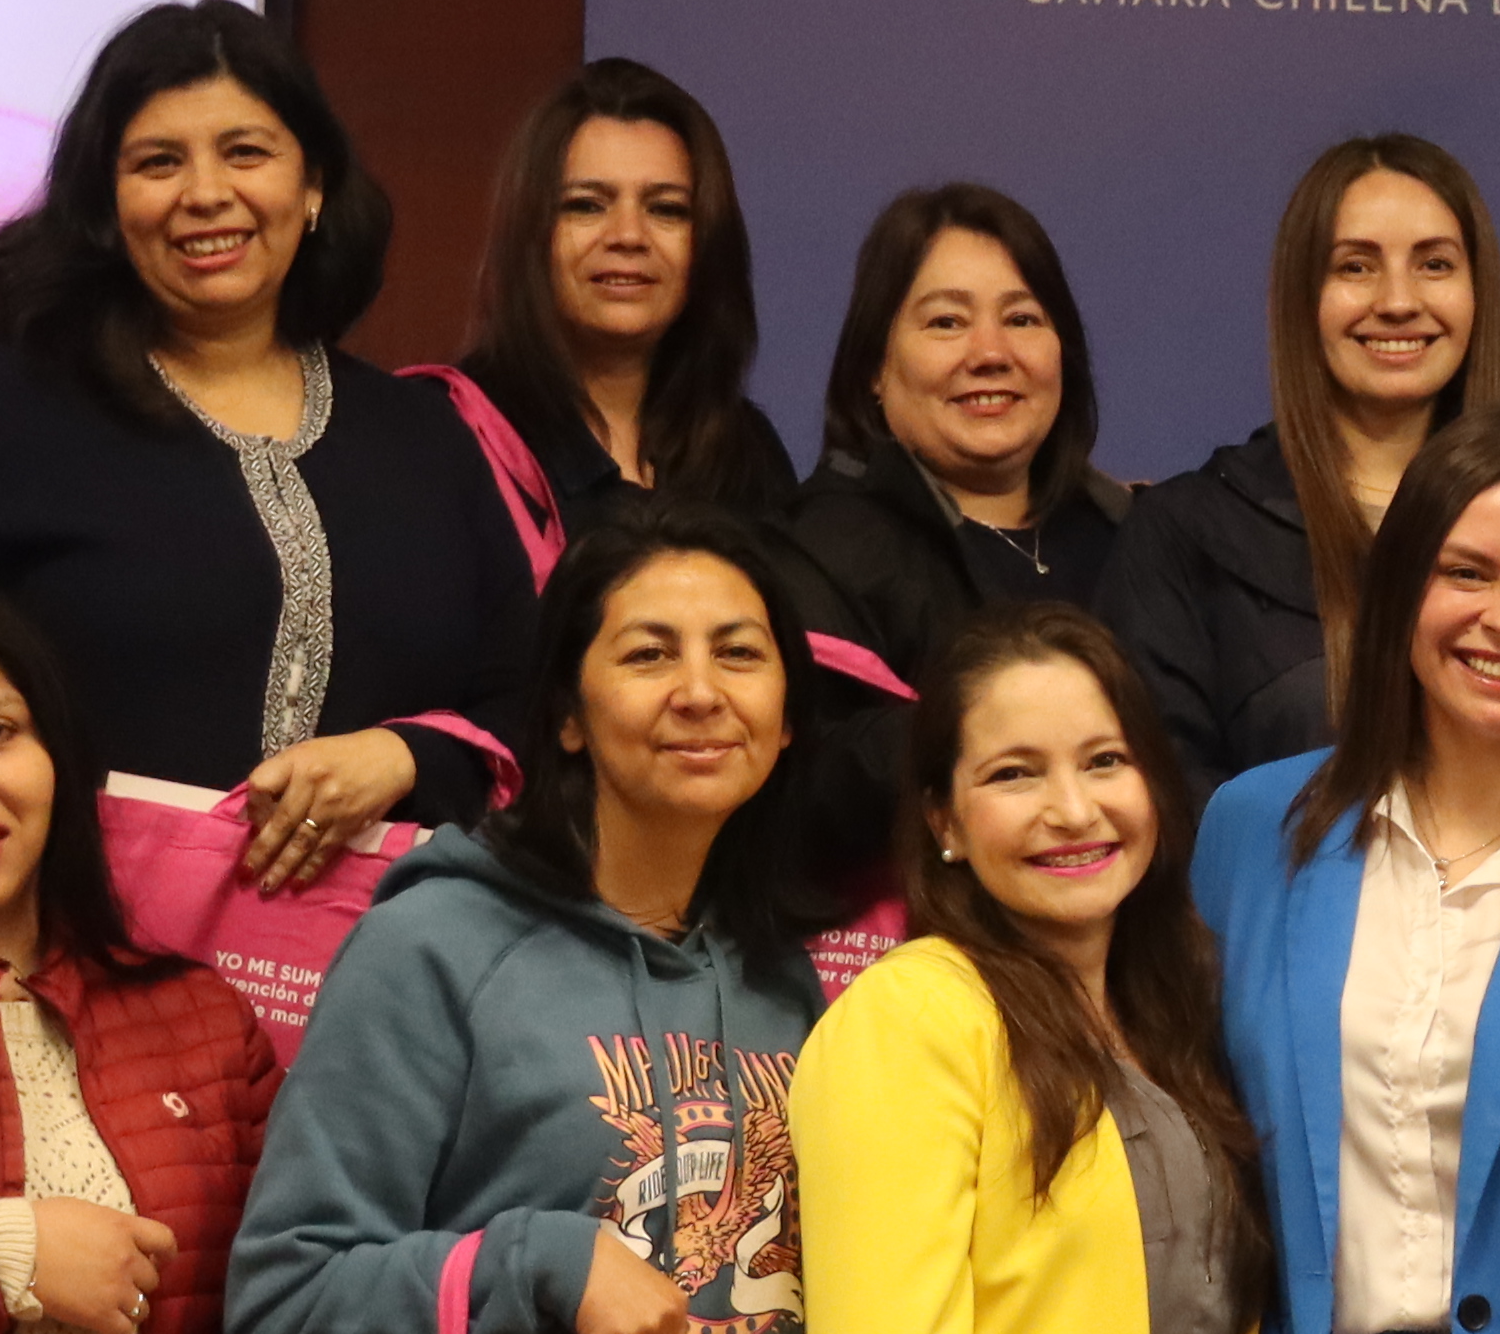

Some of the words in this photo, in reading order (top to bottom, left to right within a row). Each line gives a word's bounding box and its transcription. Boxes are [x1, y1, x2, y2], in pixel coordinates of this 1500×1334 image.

[844, 931, 867, 948] ME
[216, 950, 243, 970] YO
[247, 957, 276, 978] ME
[280, 965, 324, 987] SUM
